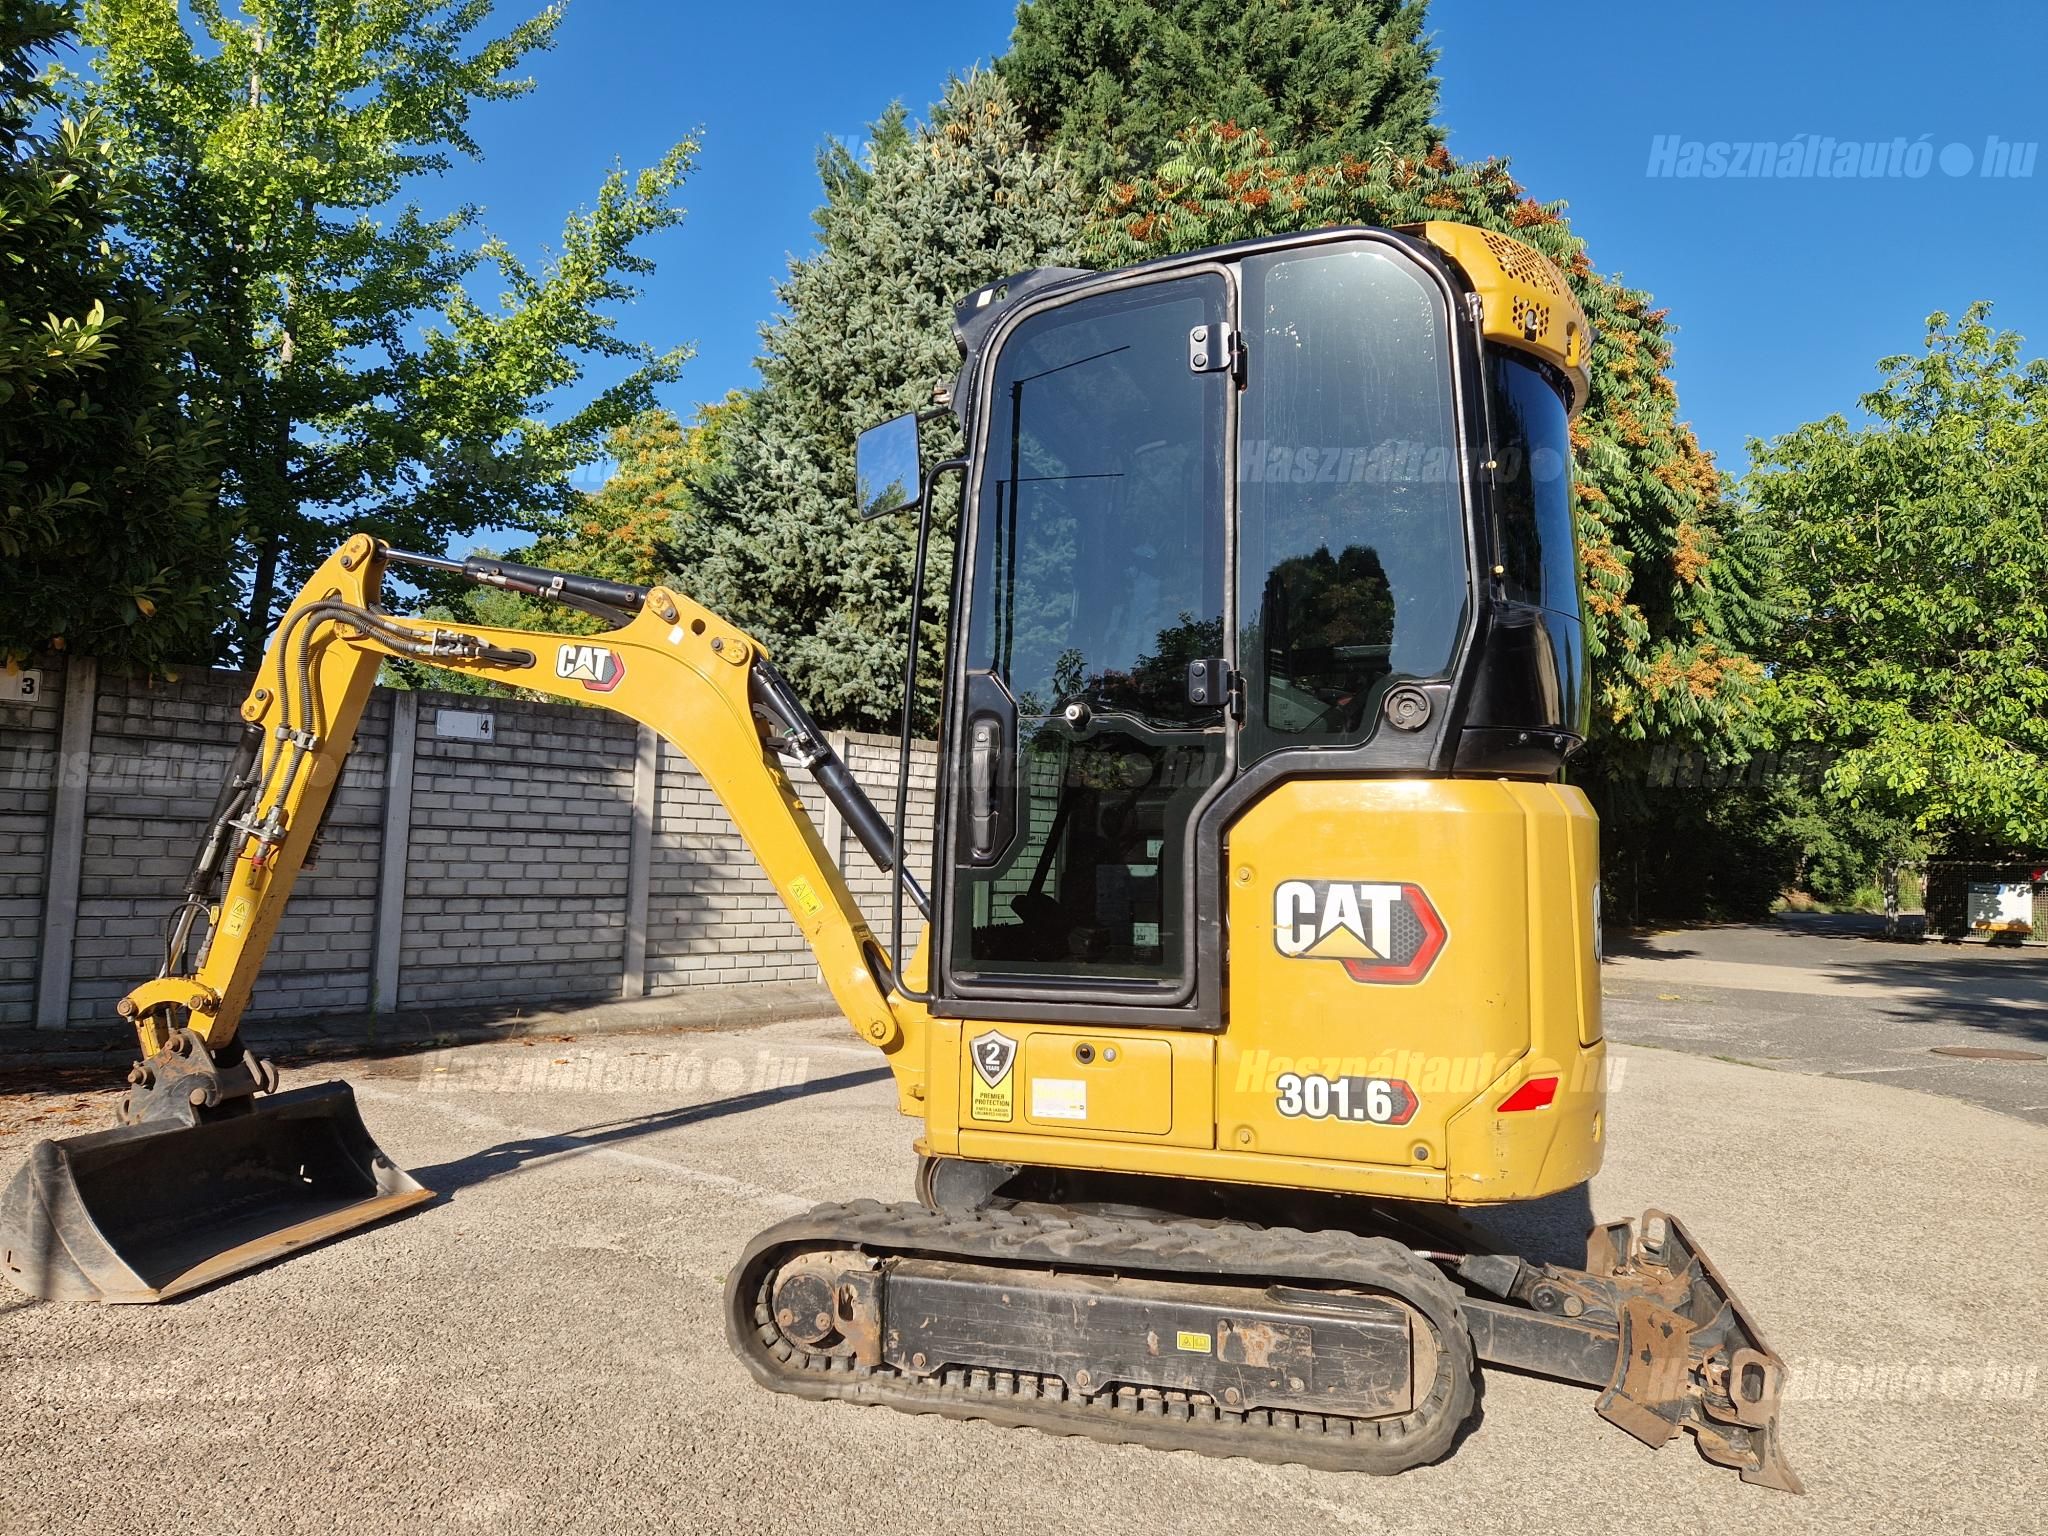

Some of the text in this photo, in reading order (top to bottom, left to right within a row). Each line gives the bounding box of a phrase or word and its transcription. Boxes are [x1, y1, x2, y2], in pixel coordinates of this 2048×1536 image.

[557, 645, 610, 681] CAT
[22, 677, 35, 695] 3
[480, 719, 490, 734] 4
[1275, 881, 1402, 960] CAT
[985, 1043, 1000, 1065] 2
[974, 1099, 1010, 1107] PROTECTION
[979, 1092, 1005, 1100] PREMIER
[1276, 1074, 1394, 1122] 301.6
